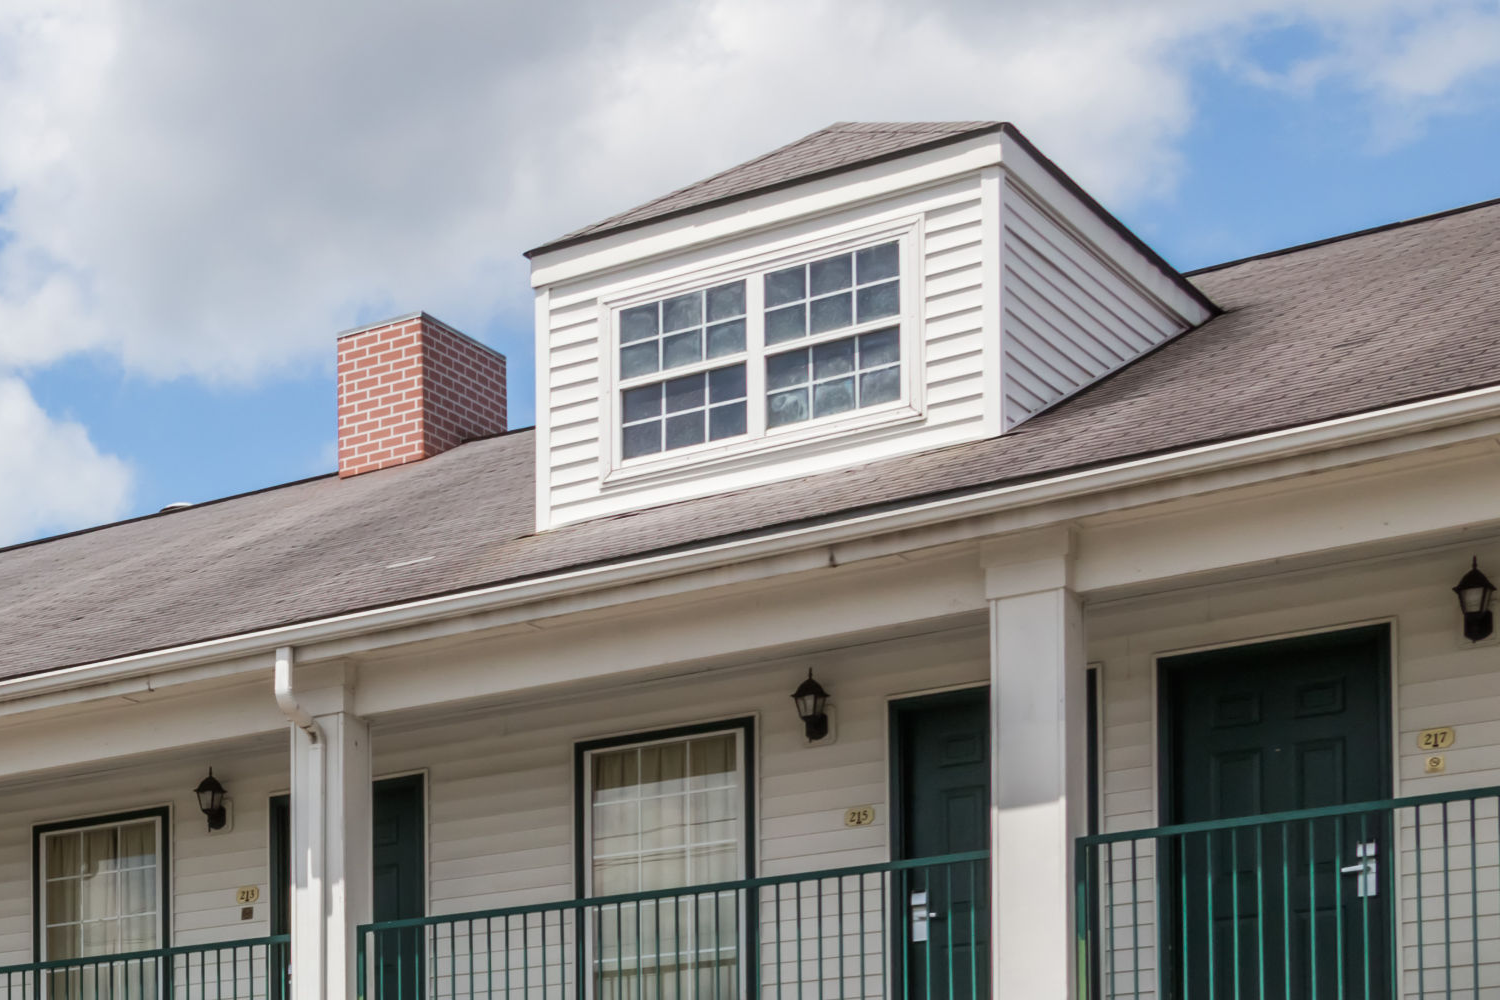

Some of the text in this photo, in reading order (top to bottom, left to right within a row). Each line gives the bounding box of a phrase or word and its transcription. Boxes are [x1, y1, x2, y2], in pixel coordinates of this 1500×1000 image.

[1424, 731, 1448, 748] 217
[849, 810, 869, 825] 215
[239, 889, 255, 902] 213
